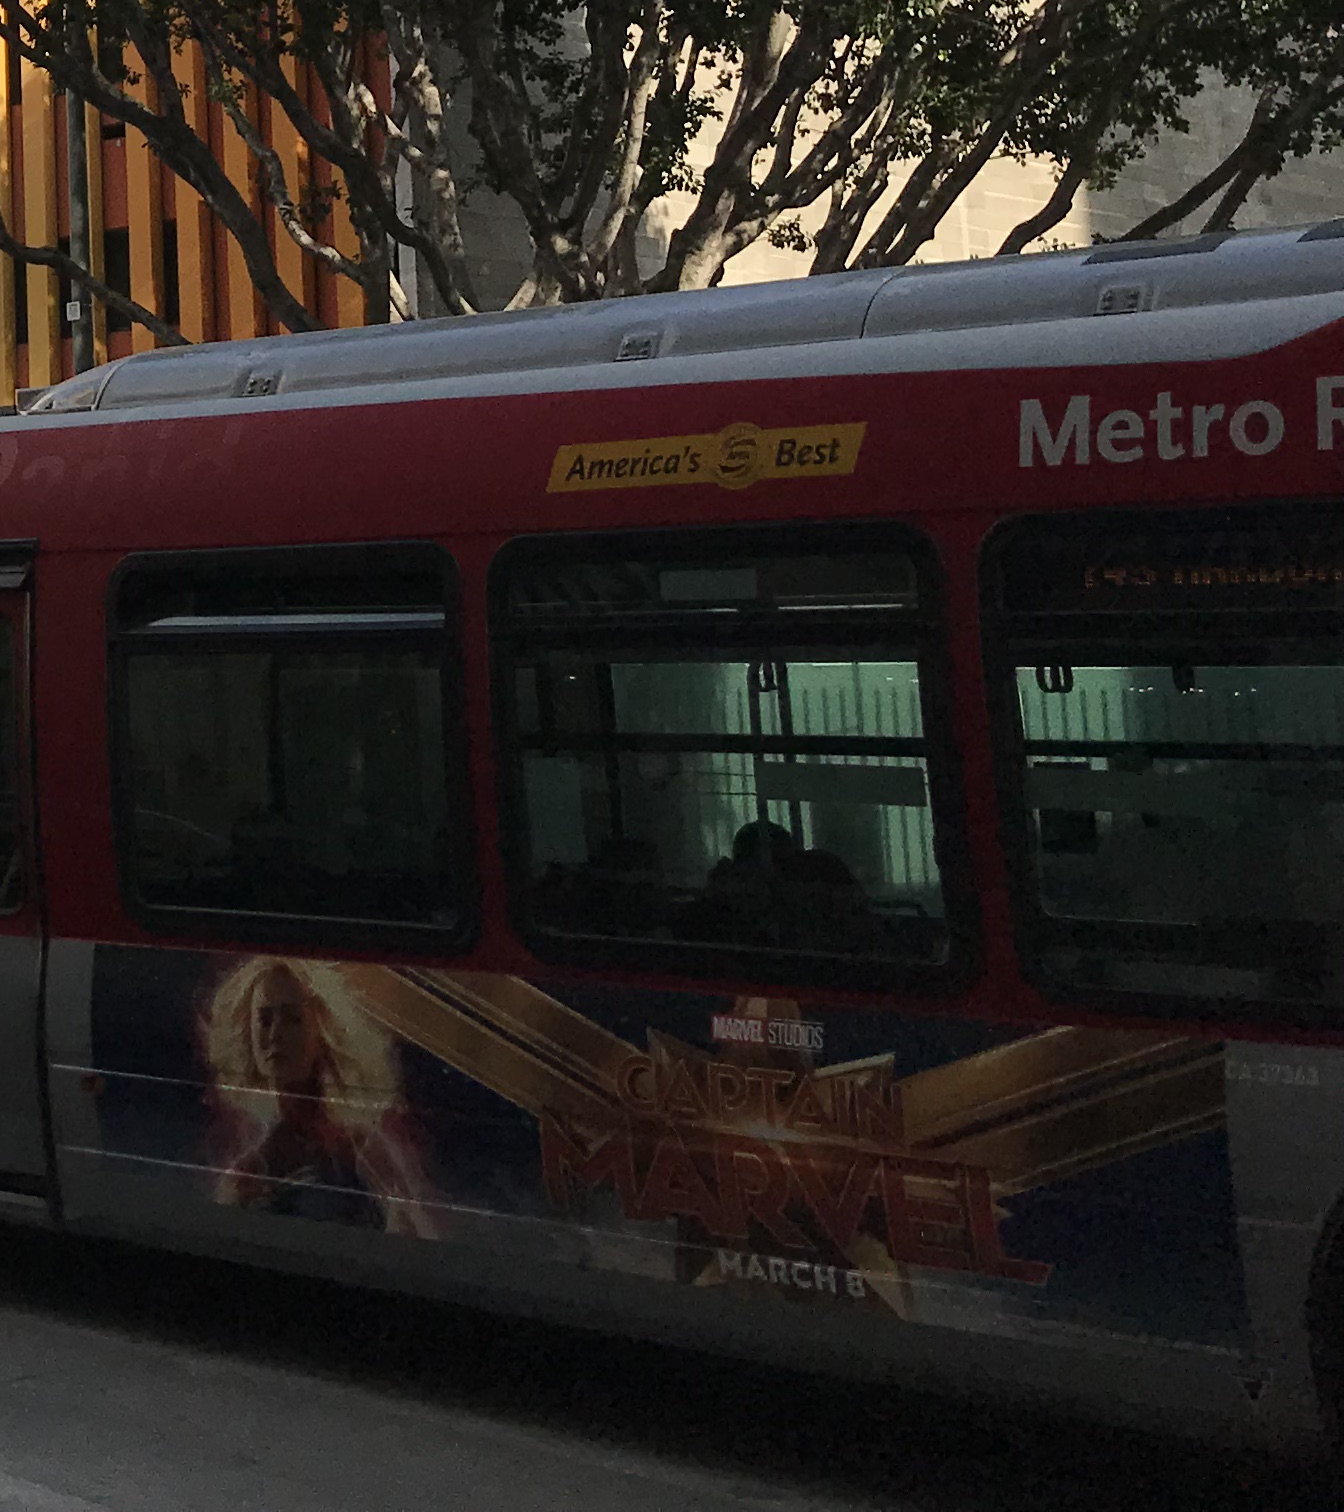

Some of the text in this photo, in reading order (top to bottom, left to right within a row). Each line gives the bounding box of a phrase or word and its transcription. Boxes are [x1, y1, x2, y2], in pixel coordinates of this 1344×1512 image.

[1018, 390, 1285, 468] Metro
[565, 438, 841, 481] America's Best
[712, 1016, 825, 1050] MARVEL STUDIOS
[615, 1053, 906, 1144] CAPTAIN
[539, 1105, 1053, 1285] MARVEL
[718, 1251, 838, 1294] MARCH
